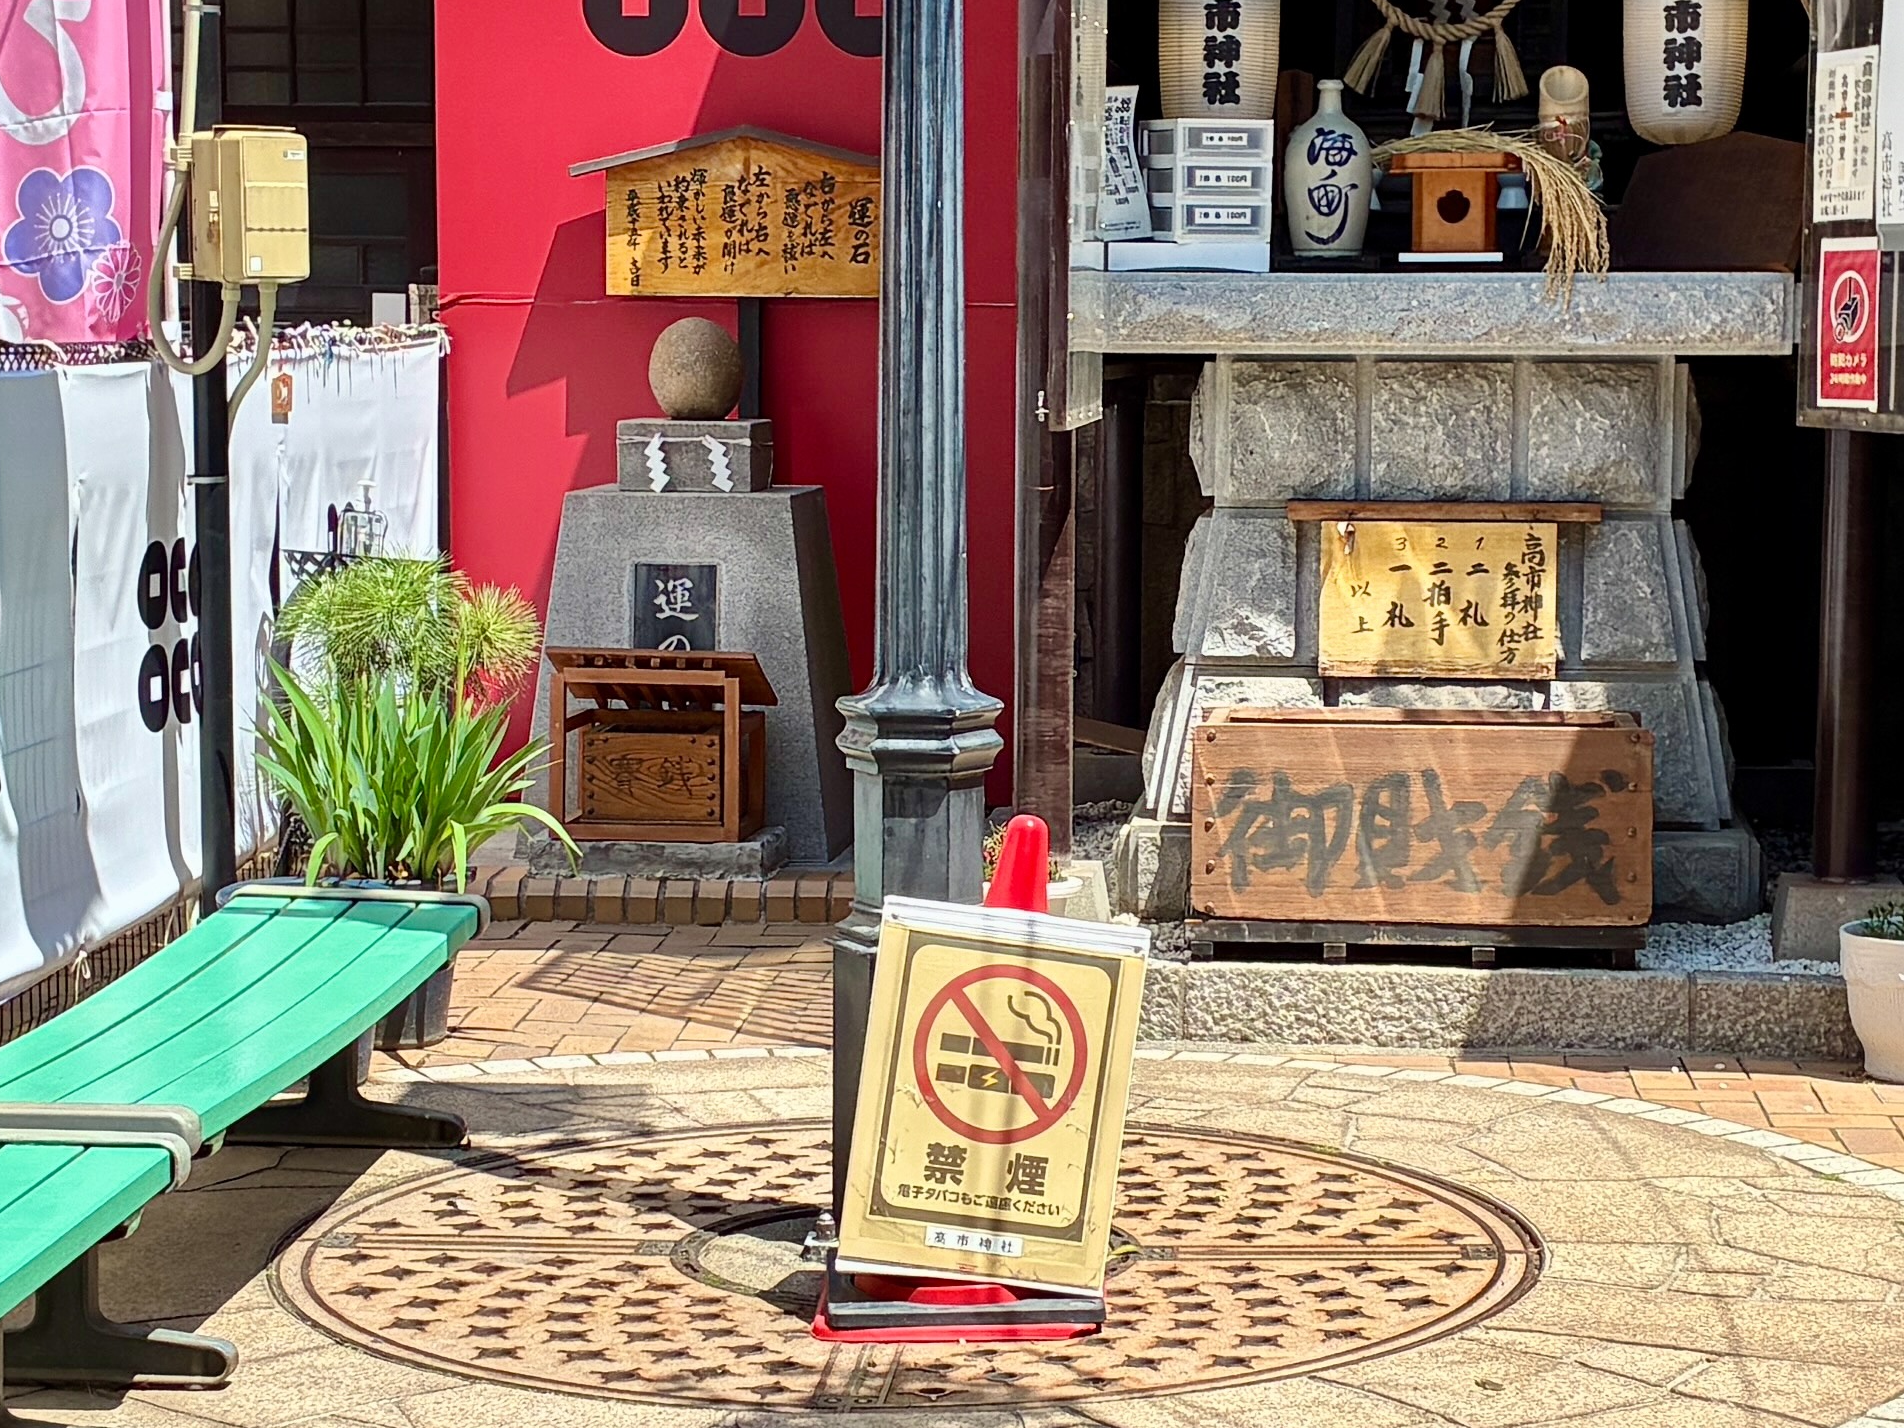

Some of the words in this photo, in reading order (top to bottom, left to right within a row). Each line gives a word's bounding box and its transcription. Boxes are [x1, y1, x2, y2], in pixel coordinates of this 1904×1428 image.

[752, 164, 772, 258] 左から右へ
[817, 170, 837, 261] 右から左へ
[848, 196, 875, 265] 運の石
[1496, 561, 1524, 666] 参拝の仕方
[1518, 523, 1547, 644] 高市神社
[896, 1182, 1062, 1218] 電子タバコもご遠慮ください
